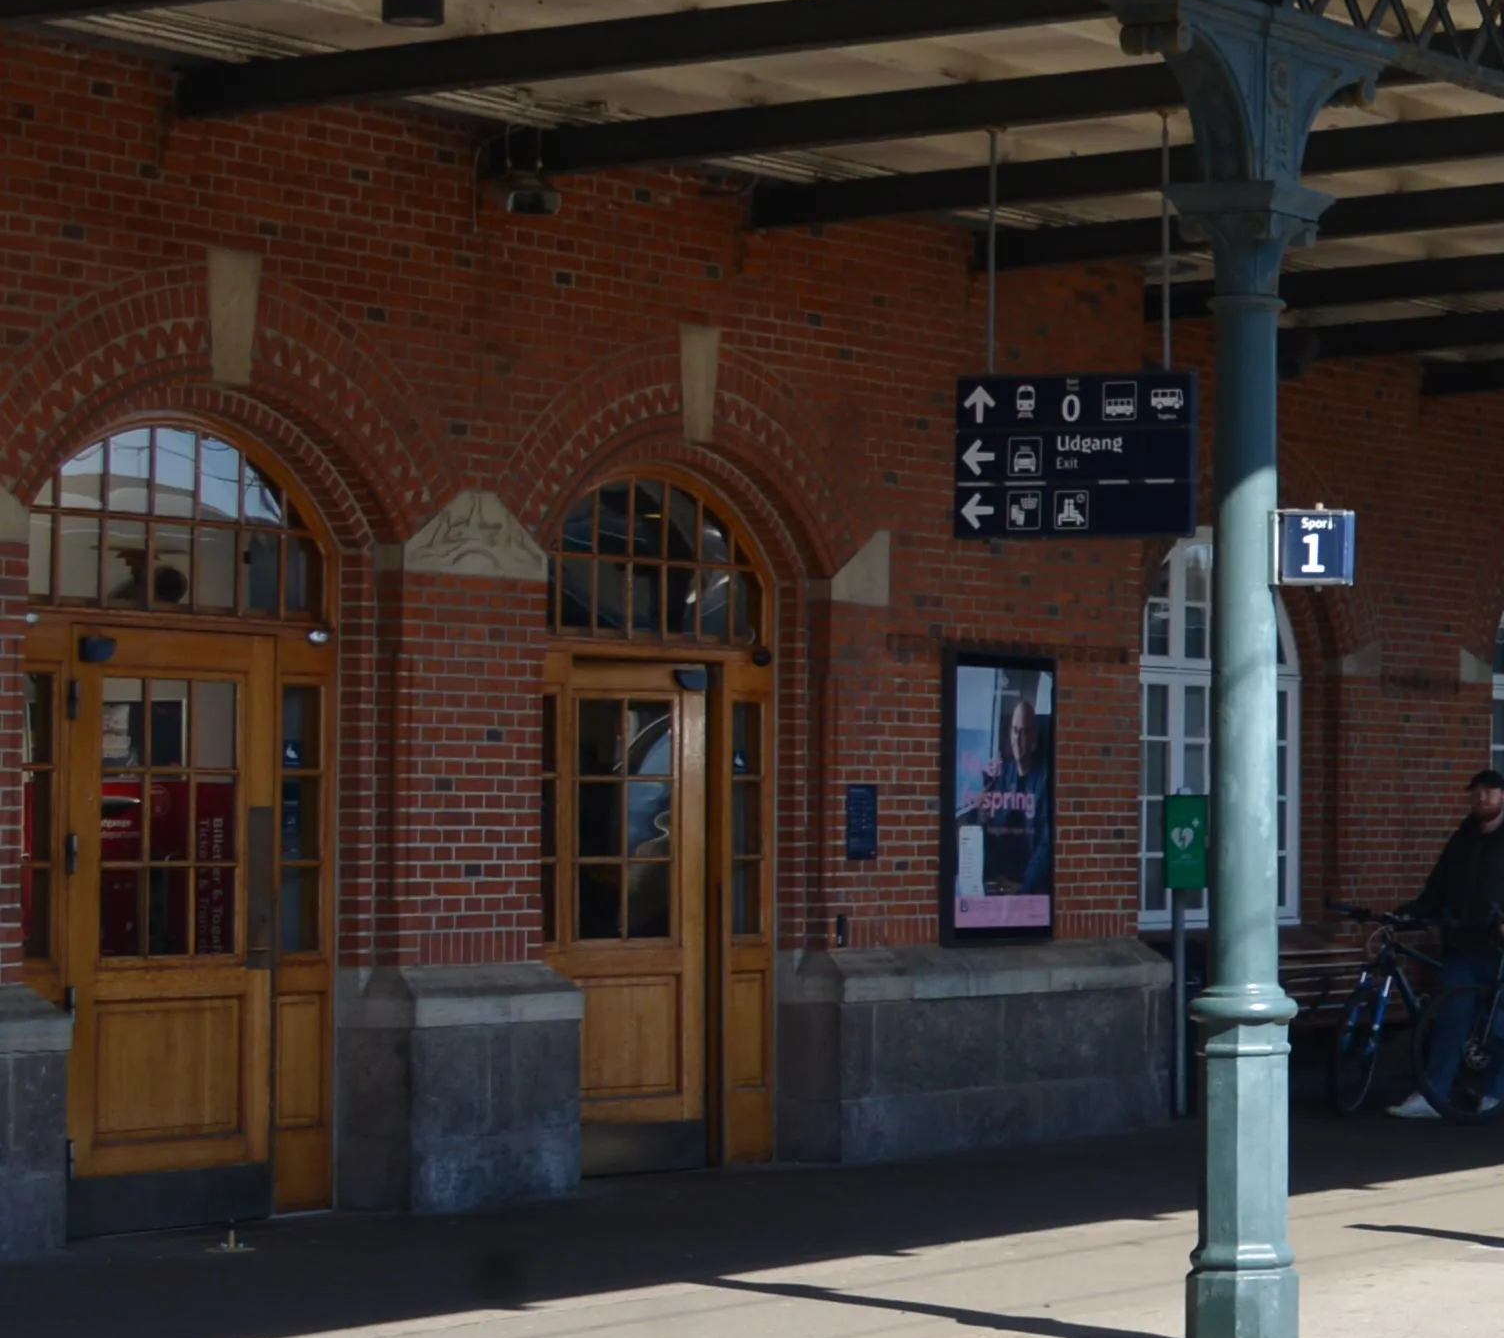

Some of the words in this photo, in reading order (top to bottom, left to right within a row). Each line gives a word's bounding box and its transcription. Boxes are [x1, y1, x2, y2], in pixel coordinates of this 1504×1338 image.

[1061, 394, 1081, 422] 0
[1056, 435, 1123, 453] Udgang
[1055, 457, 1079, 470] Exit
[1301, 516, 1329, 531] Spor
[1301, 533, 1325, 573] 1
[212, 817, 224, 883] Billeter
